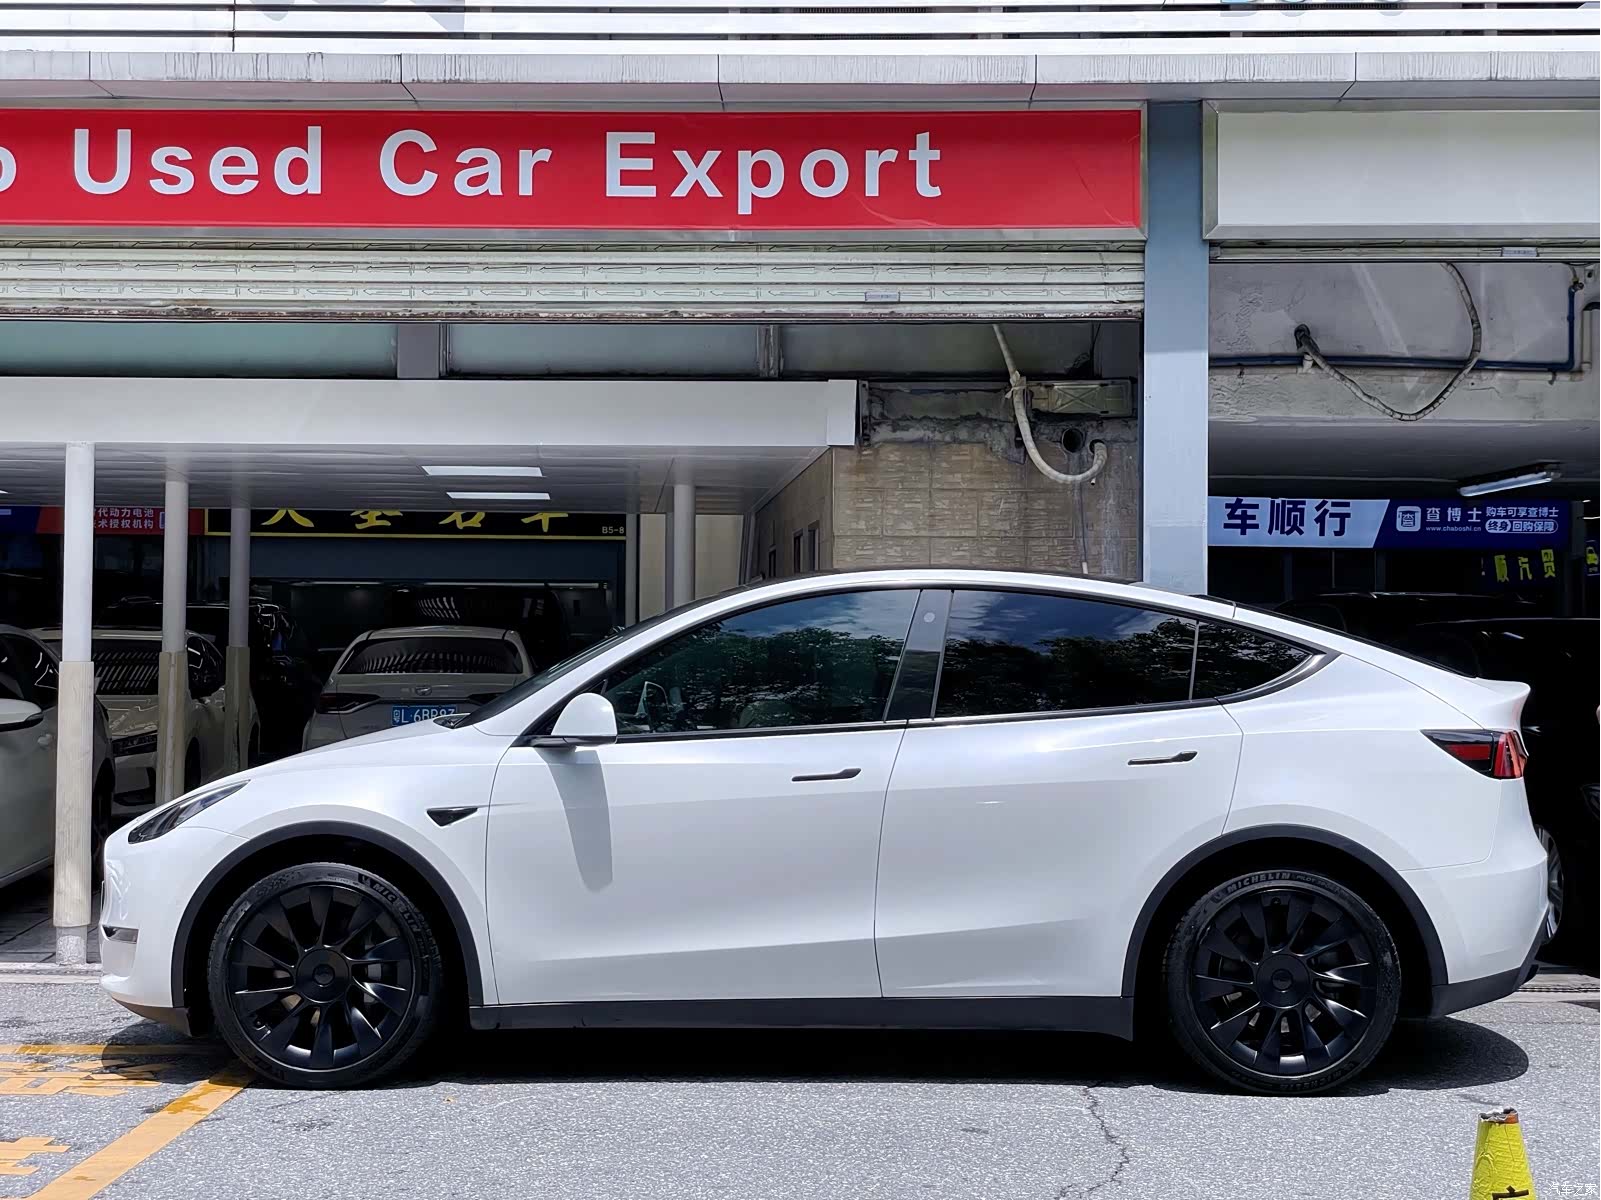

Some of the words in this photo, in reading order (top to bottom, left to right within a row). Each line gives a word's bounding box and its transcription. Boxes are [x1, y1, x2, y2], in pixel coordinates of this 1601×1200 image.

[73, 125, 323, 197] Used
[378, 129, 553, 197] Car
[604, 130, 943, 216] Export
[94, 507, 154, 518] 代动力电池
[1222, 497, 1352, 537] 车顺行
[1425, 506, 1483, 523] 查博士
[1485, 506, 1560, 518] 购车可享查博士
[94, 518, 154, 529] 术授权机构
[601, 525, 625, 534] B5-8
[1227, 872, 1291, 894] MICHELIN
